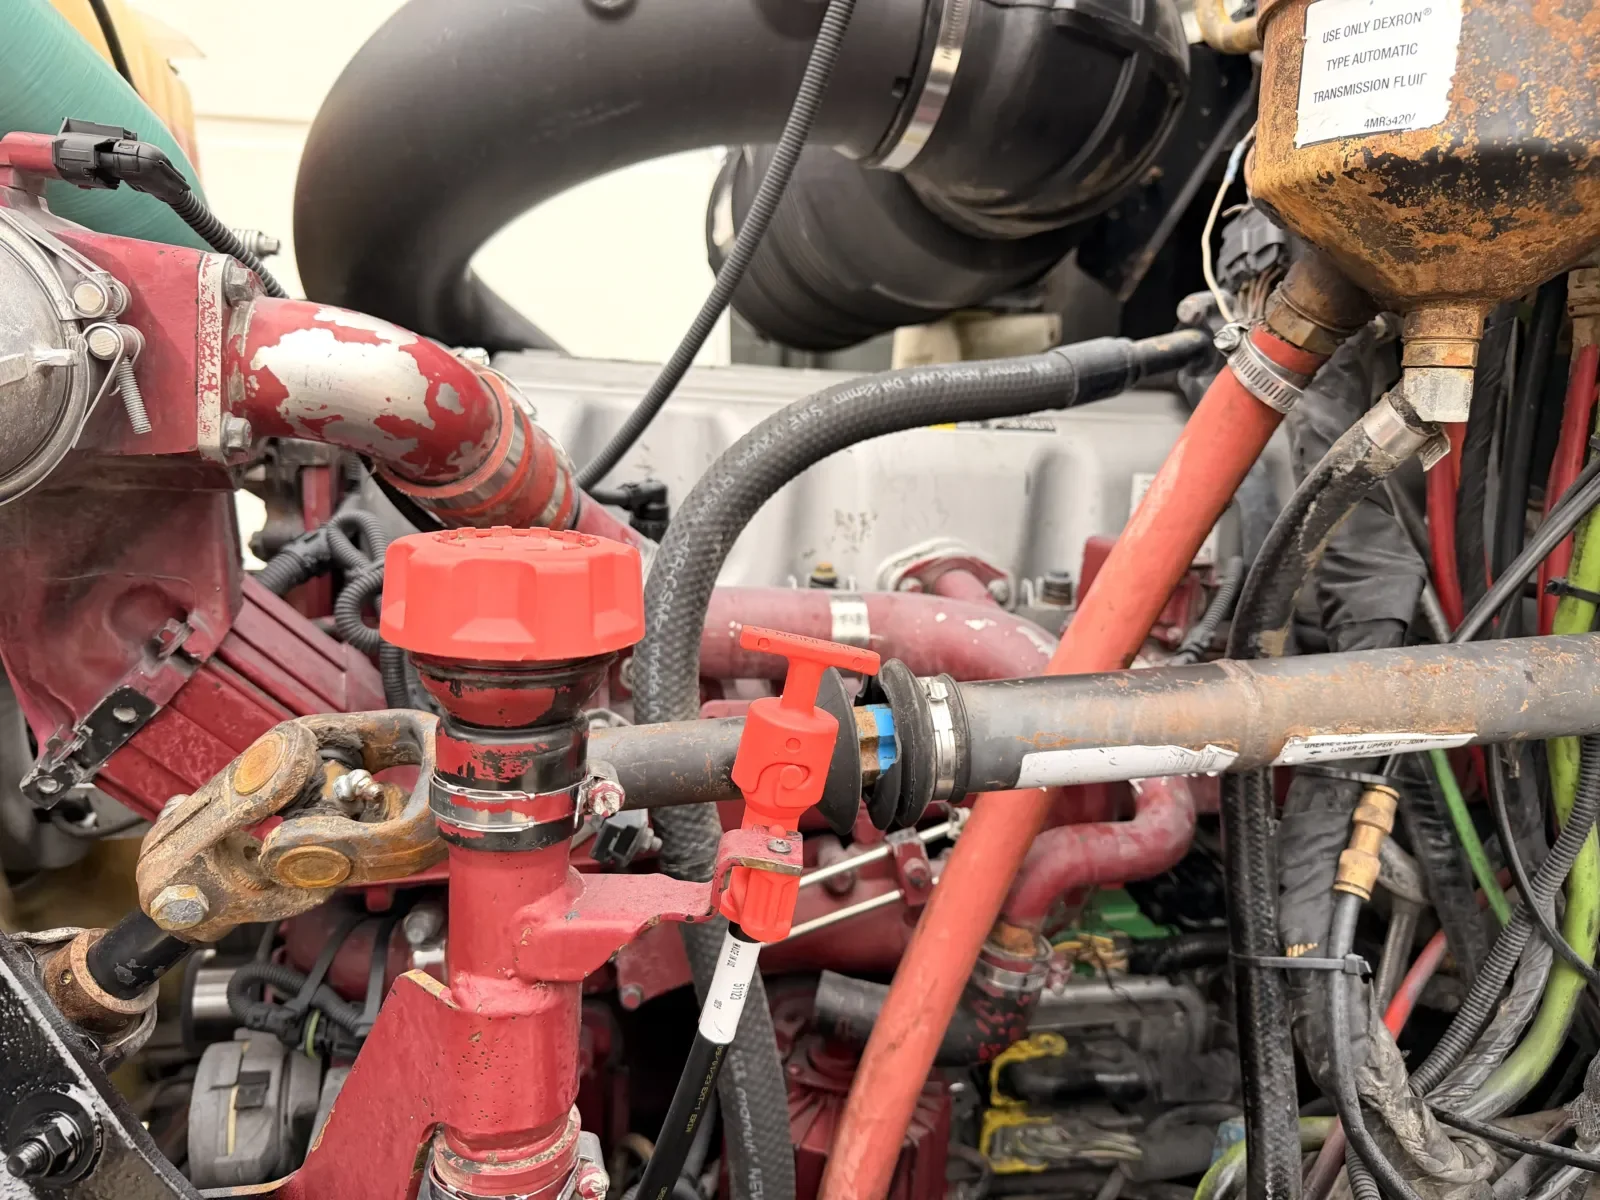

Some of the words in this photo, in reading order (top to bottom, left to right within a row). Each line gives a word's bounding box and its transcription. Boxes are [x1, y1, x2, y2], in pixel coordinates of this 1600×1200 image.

[1322, 27, 1342, 44] USE
[1343, 20, 1371, 38] ONLY
[1326, 55, 1350, 71] TYPE
[1352, 42, 1418, 66] AUTOMATIC
[1313, 77, 1390, 104] TRANSMISSION
